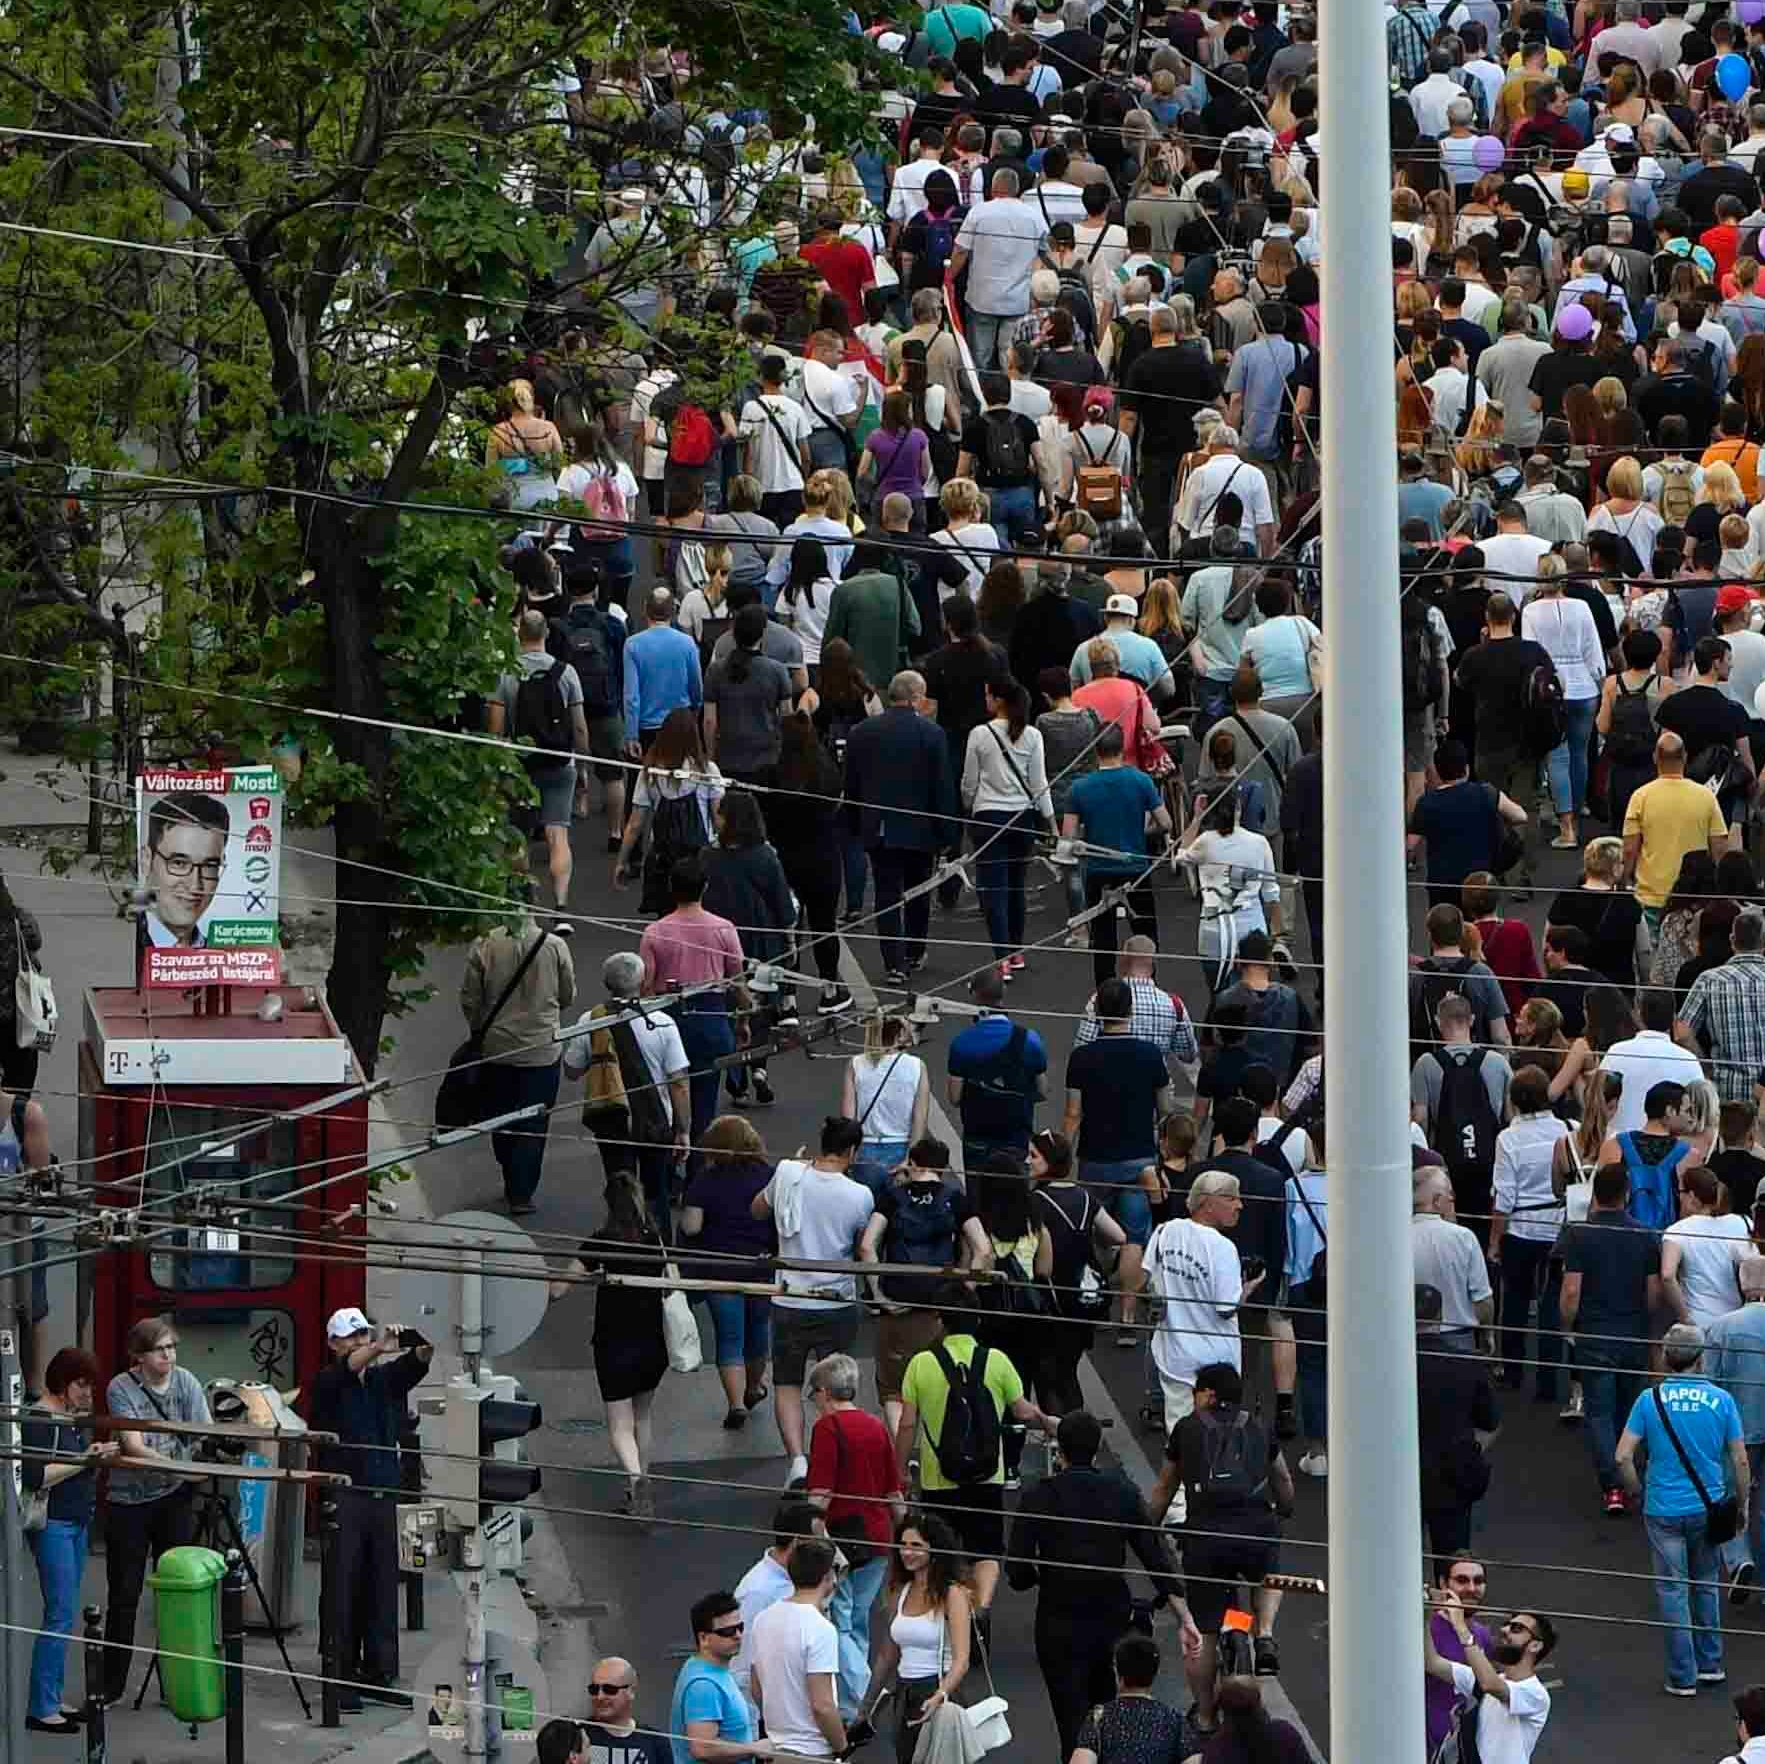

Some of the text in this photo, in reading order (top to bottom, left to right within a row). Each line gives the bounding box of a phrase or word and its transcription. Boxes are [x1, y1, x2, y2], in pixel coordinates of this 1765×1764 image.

[146, 774, 278, 791] Változást! Most!
[214, 924, 273, 940] Karácsony
[151, 952, 273, 966] Szavazz az MSZP-
[151, 966, 218, 981] Párbeszéd
[1462, 1123, 1476, 1159] FILA
